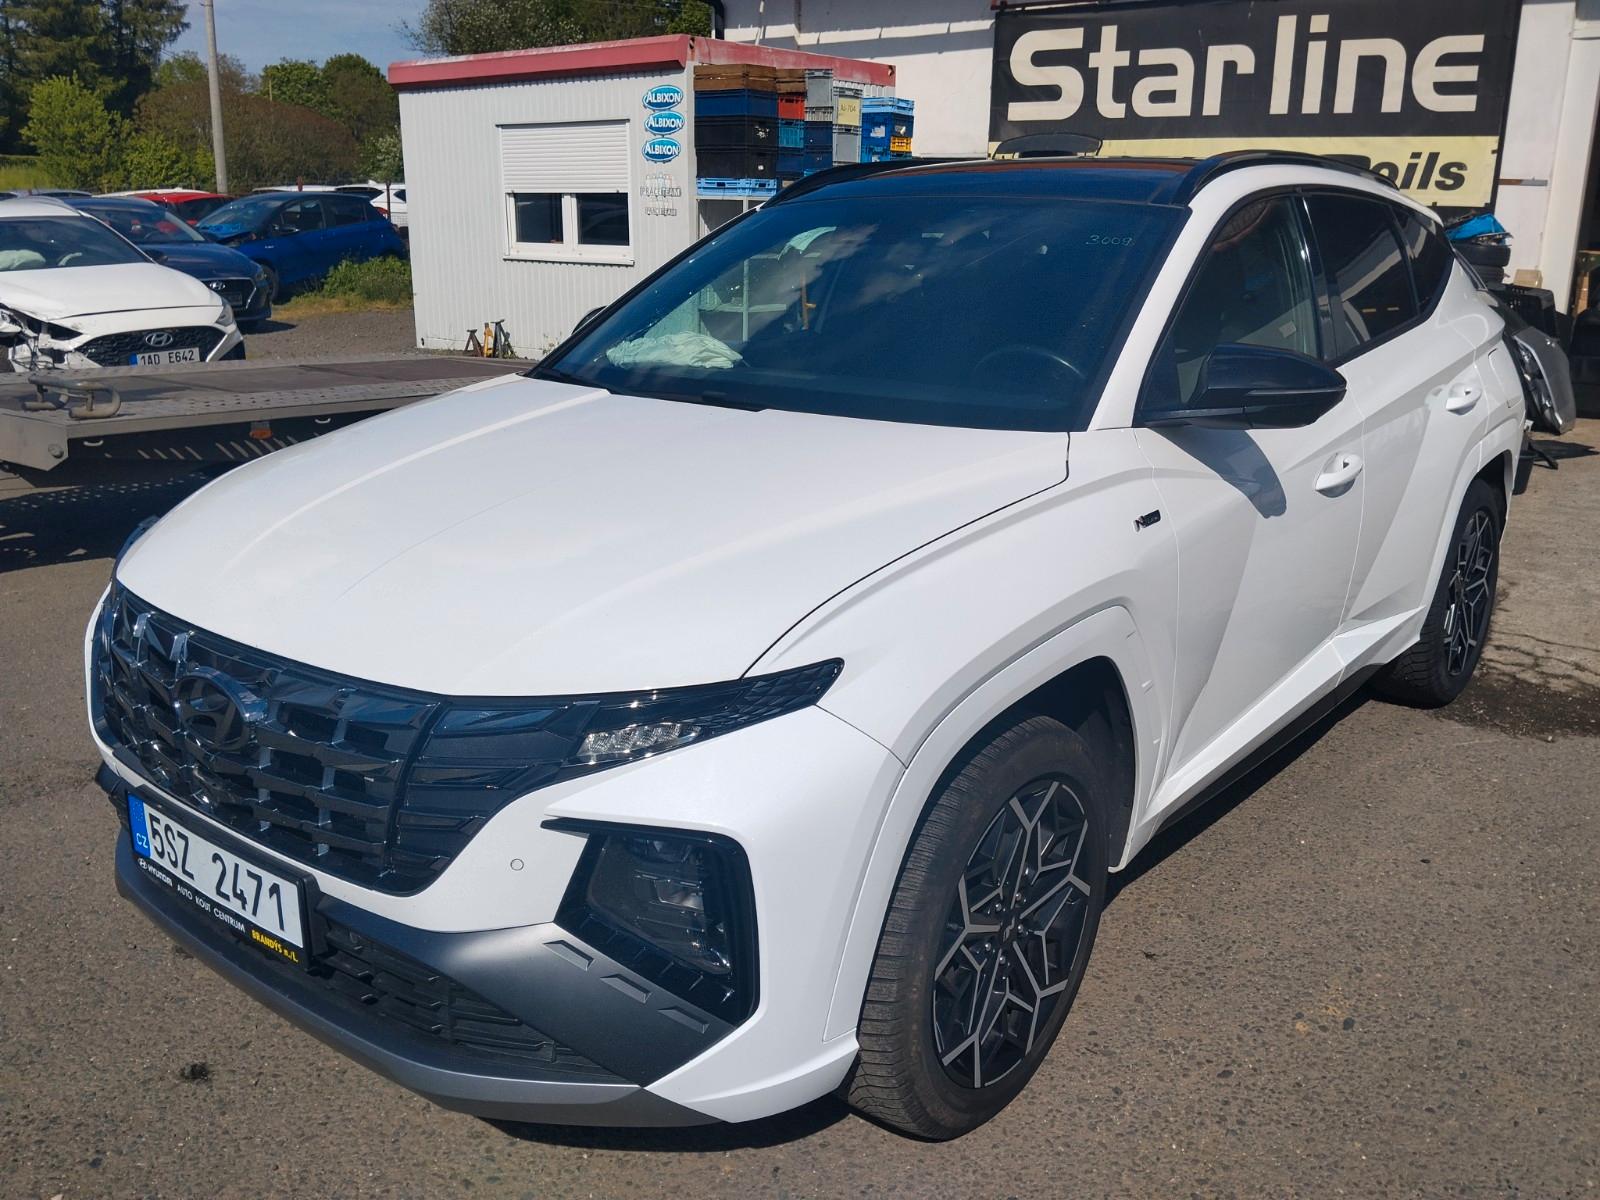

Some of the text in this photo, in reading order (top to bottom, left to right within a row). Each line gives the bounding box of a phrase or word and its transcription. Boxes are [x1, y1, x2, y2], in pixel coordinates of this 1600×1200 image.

[1007, 14, 1485, 122] Starline
[646, 91, 681, 103] ALBIXON
[648, 116, 683, 128] ALBIXON
[645, 142, 679, 155] ALBIXON
[1371, 151, 1468, 191] oils
[141, 349, 195, 366] 1AD E642
[136, 832, 149, 849] CZ
[149, 812, 286, 932] 5SZ 2471
[177, 884, 193, 900] AUTO
[213, 908, 246, 933] CENTRUM
